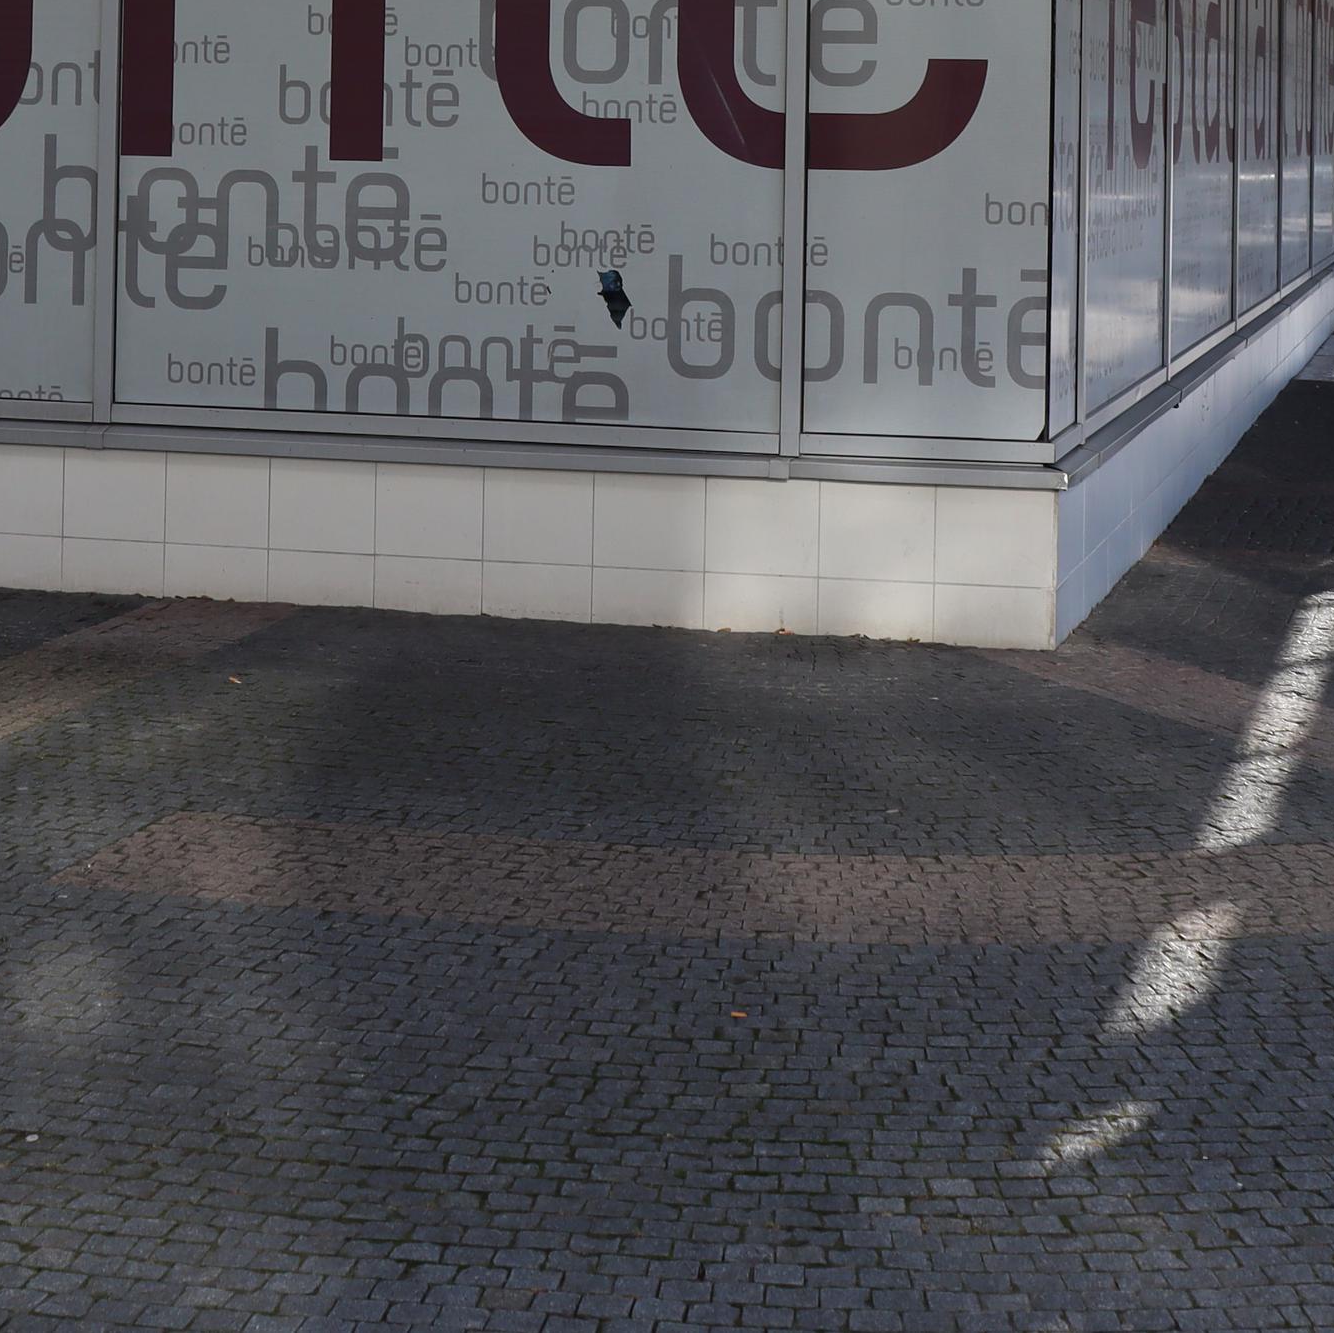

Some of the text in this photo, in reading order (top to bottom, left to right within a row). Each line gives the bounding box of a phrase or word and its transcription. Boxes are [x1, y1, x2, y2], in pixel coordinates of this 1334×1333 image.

[482, 172, 576, 206] bontē
[455, 272, 548, 306] bontē
[168, 353, 256, 387] bontē
